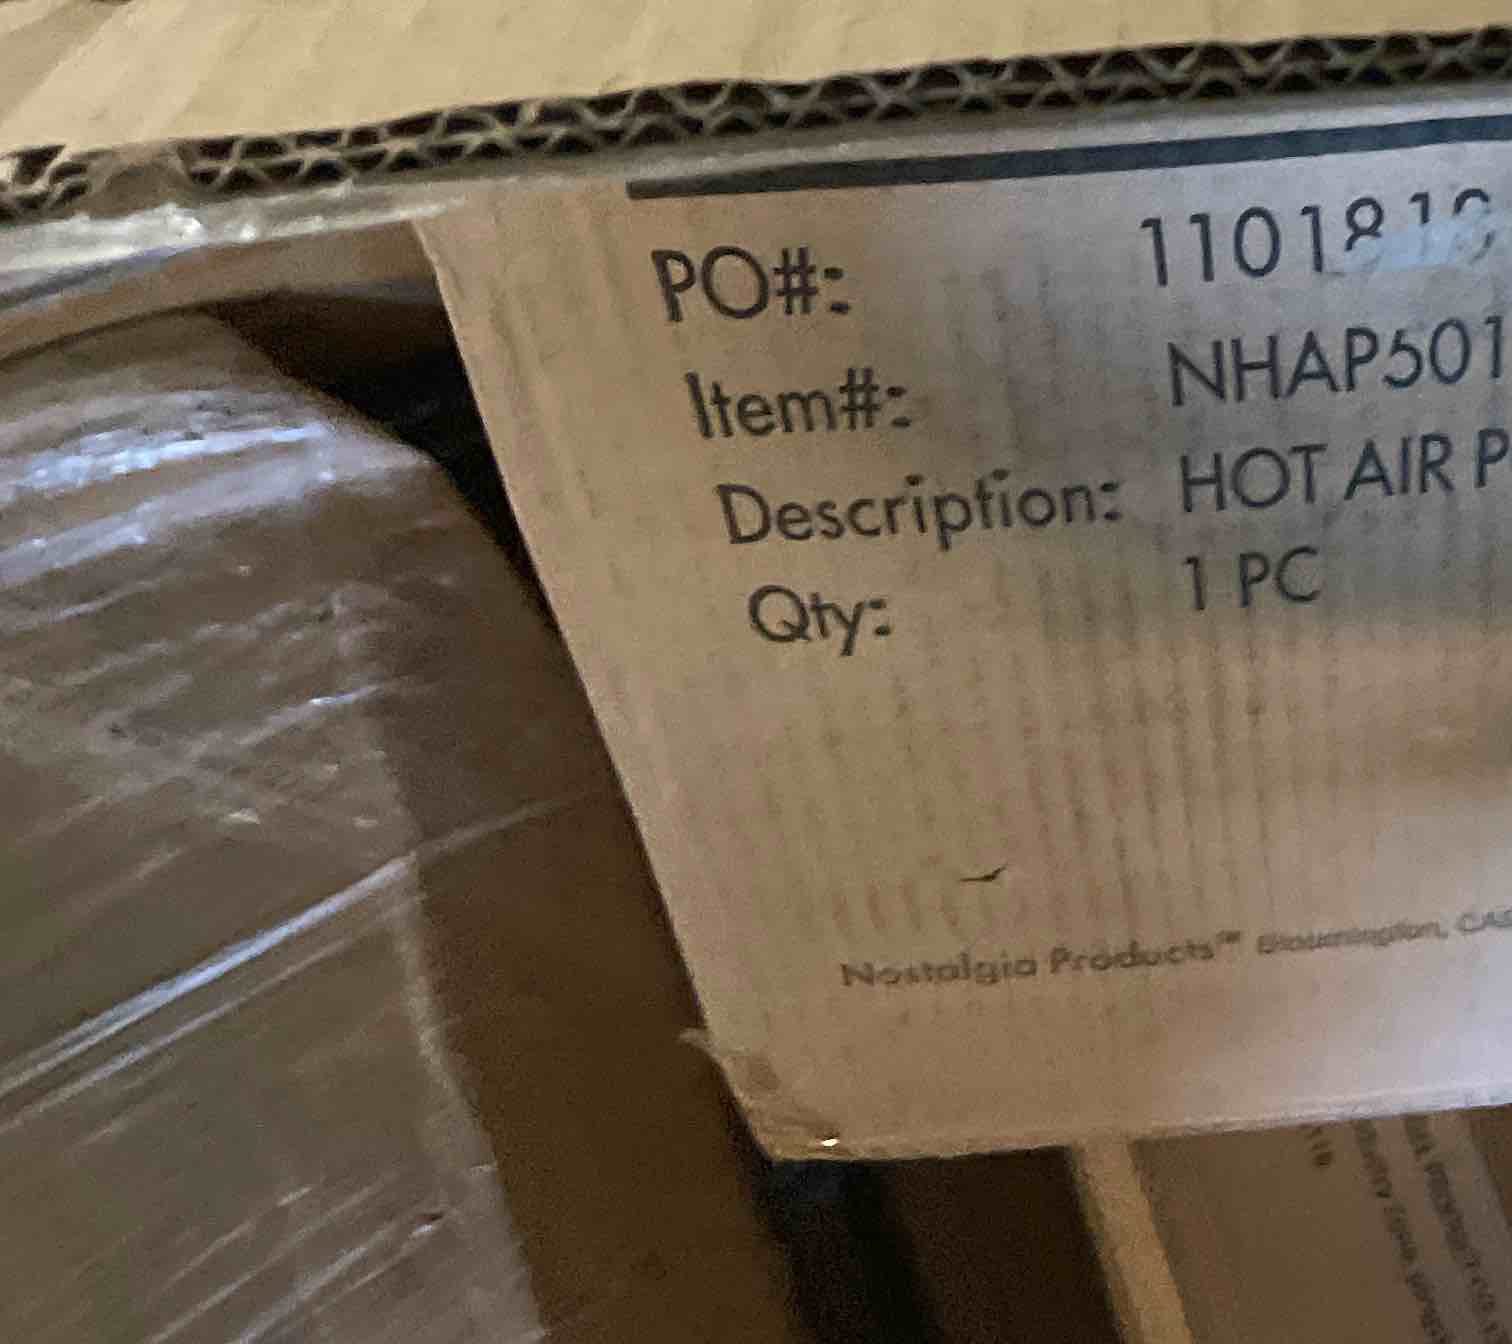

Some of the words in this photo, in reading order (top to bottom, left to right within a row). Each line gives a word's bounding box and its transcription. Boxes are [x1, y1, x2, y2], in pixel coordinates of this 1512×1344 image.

[650, 245, 852, 322] PO#:
[685, 367, 912, 439] Item#:
[716, 469, 1124, 552] Description:
[1180, 443, 1328, 512] HOT
[1343, 431, 1455, 501] AIR
[748, 584, 892, 657] Qty:
[1182, 556, 1206, 611] 1
[1238, 546, 1322, 609] PC
[840, 952, 1038, 986] Nostalgia
[1050, 938, 1215, 974] Products
